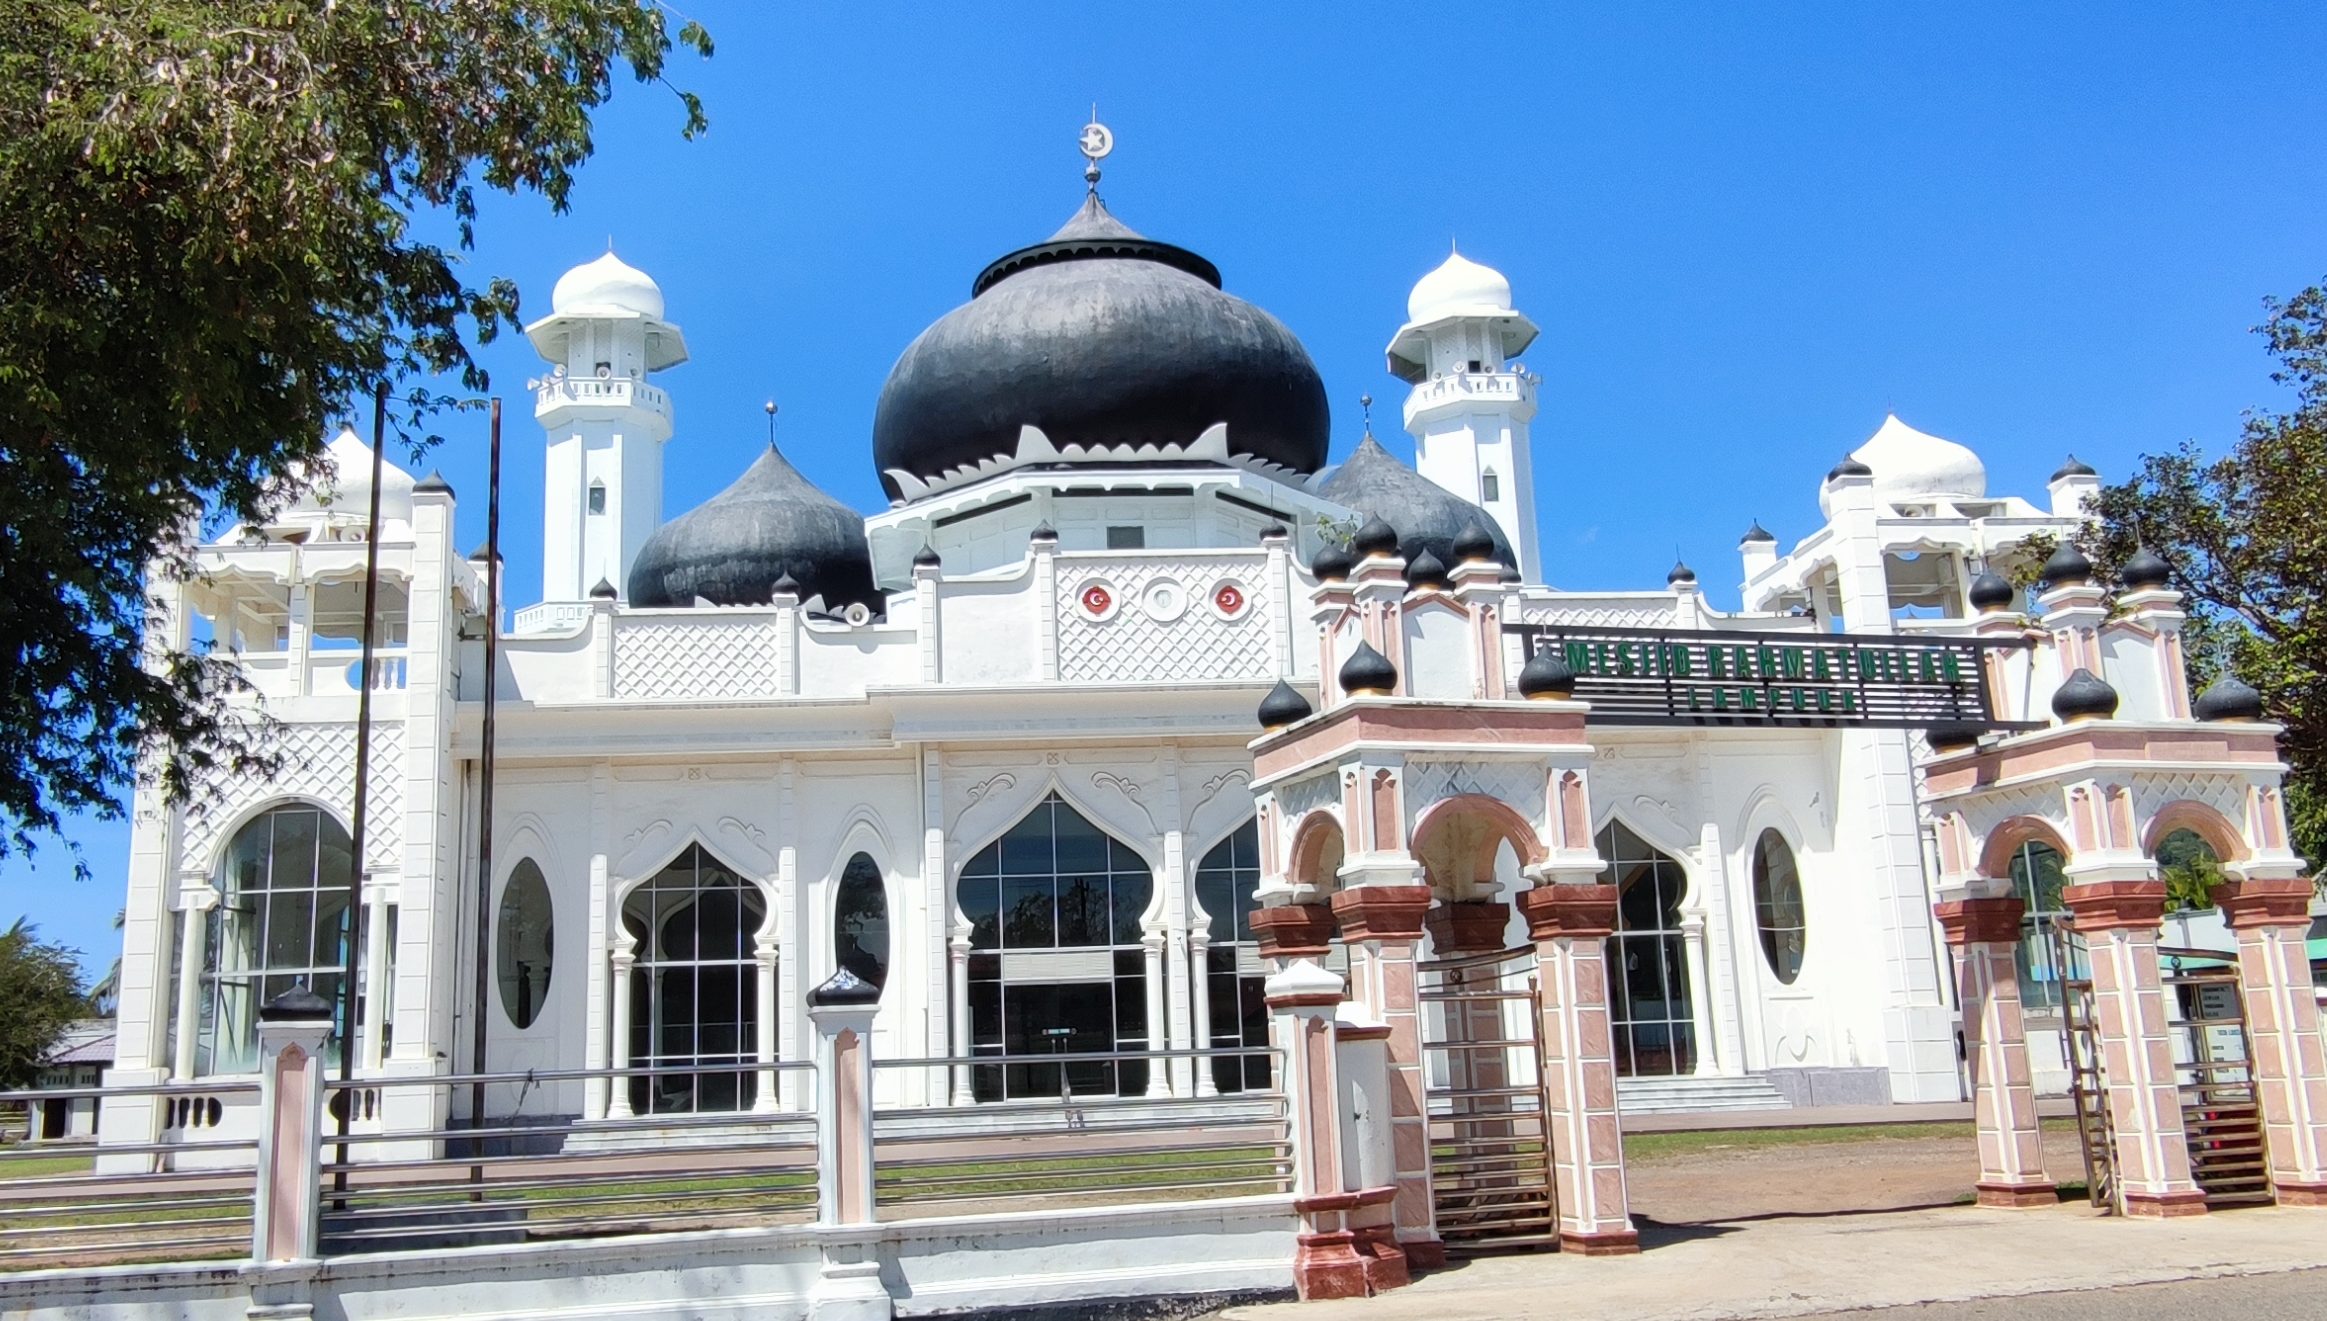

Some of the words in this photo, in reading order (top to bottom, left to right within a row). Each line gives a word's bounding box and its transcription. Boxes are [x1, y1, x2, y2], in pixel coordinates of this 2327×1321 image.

[1564, 642, 1691, 677] MESJID
[1707, 645, 1962, 682] RAHMATULLAH
[1687, 686, 1857, 711] LAMPUUK
